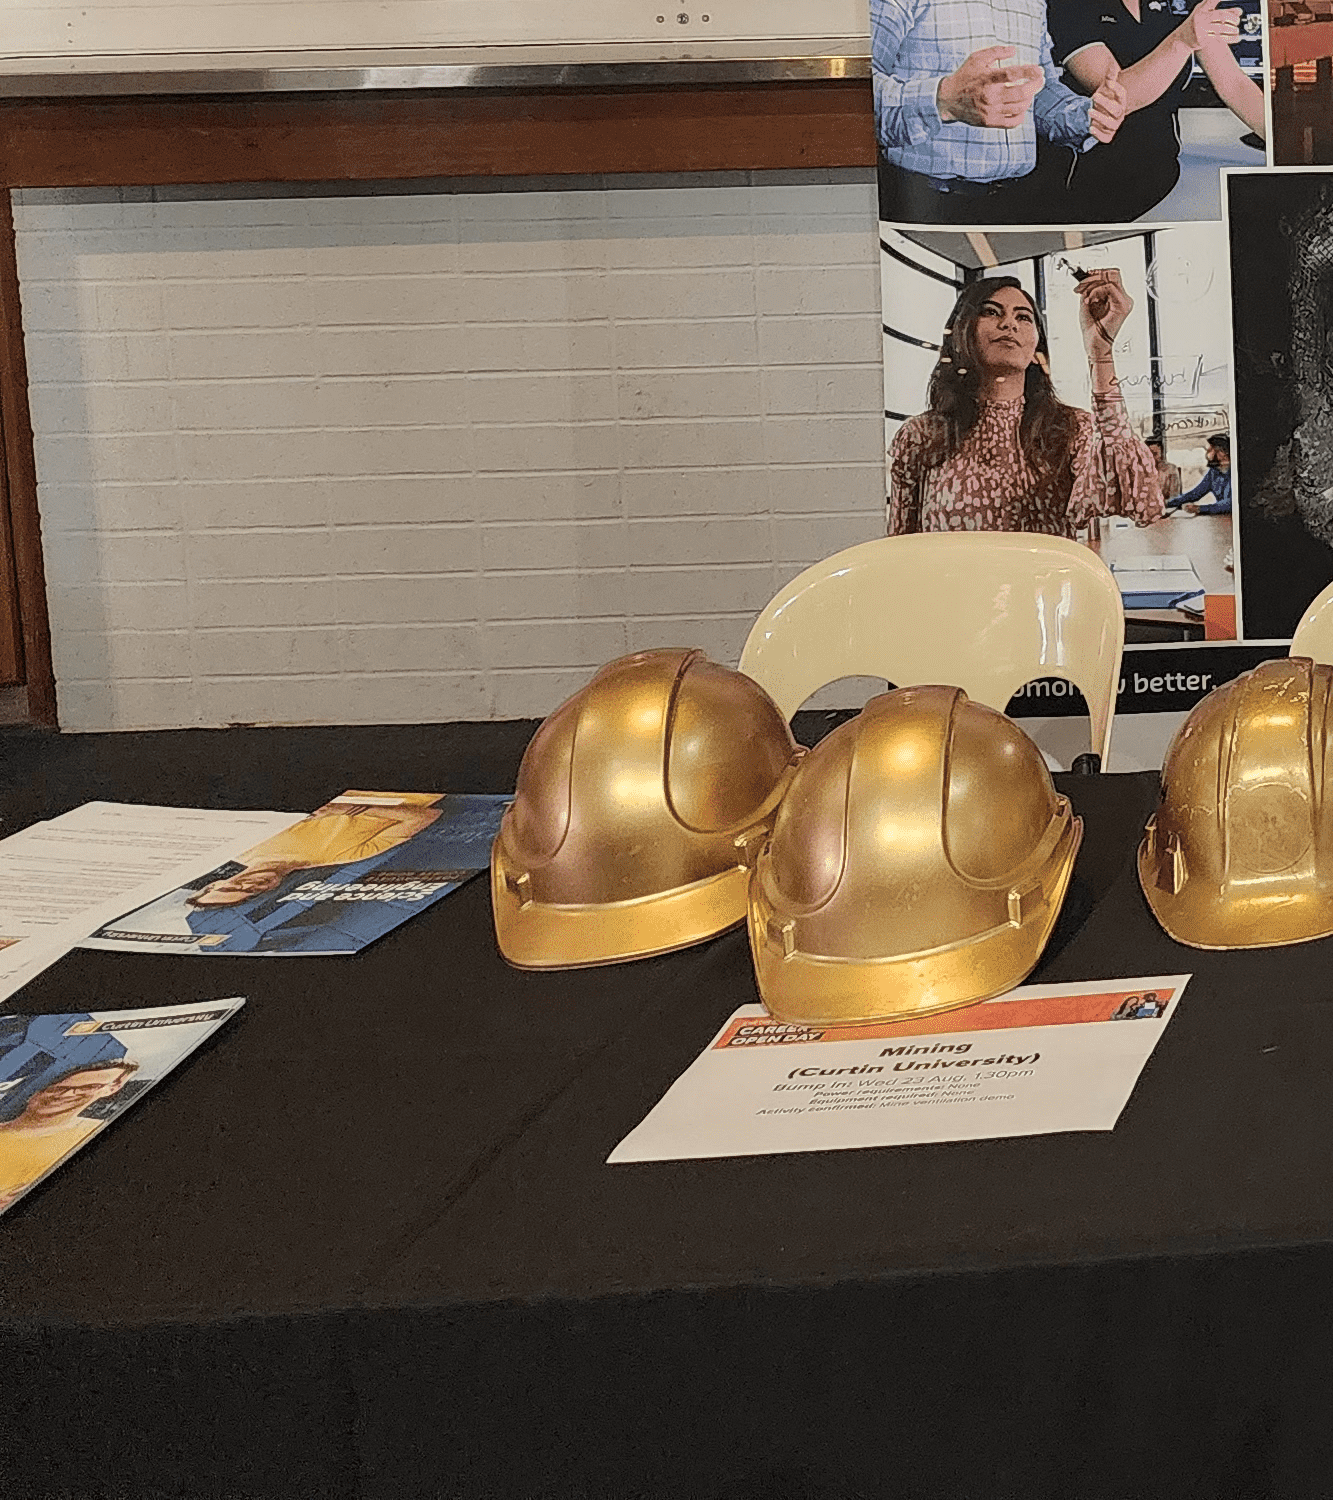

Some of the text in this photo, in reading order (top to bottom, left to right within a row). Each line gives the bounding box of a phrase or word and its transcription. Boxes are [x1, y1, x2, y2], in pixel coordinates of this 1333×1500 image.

[1134, 672, 1217, 693] better.
[101, 1012, 215, 1031] Curtin University
[731, 1033, 821, 1045] OPEN DAY
[878, 1042, 974, 1057] Mining
[787, 1052, 1041, 1080] (Curtin University)
[772, 1083, 826, 1092] Bump
[857, 1077, 899, 1088] Wed
[900, 1076, 925, 1085] 23
[813, 1090, 855, 1098] Power
[755, 1107, 807, 1115] Activity
